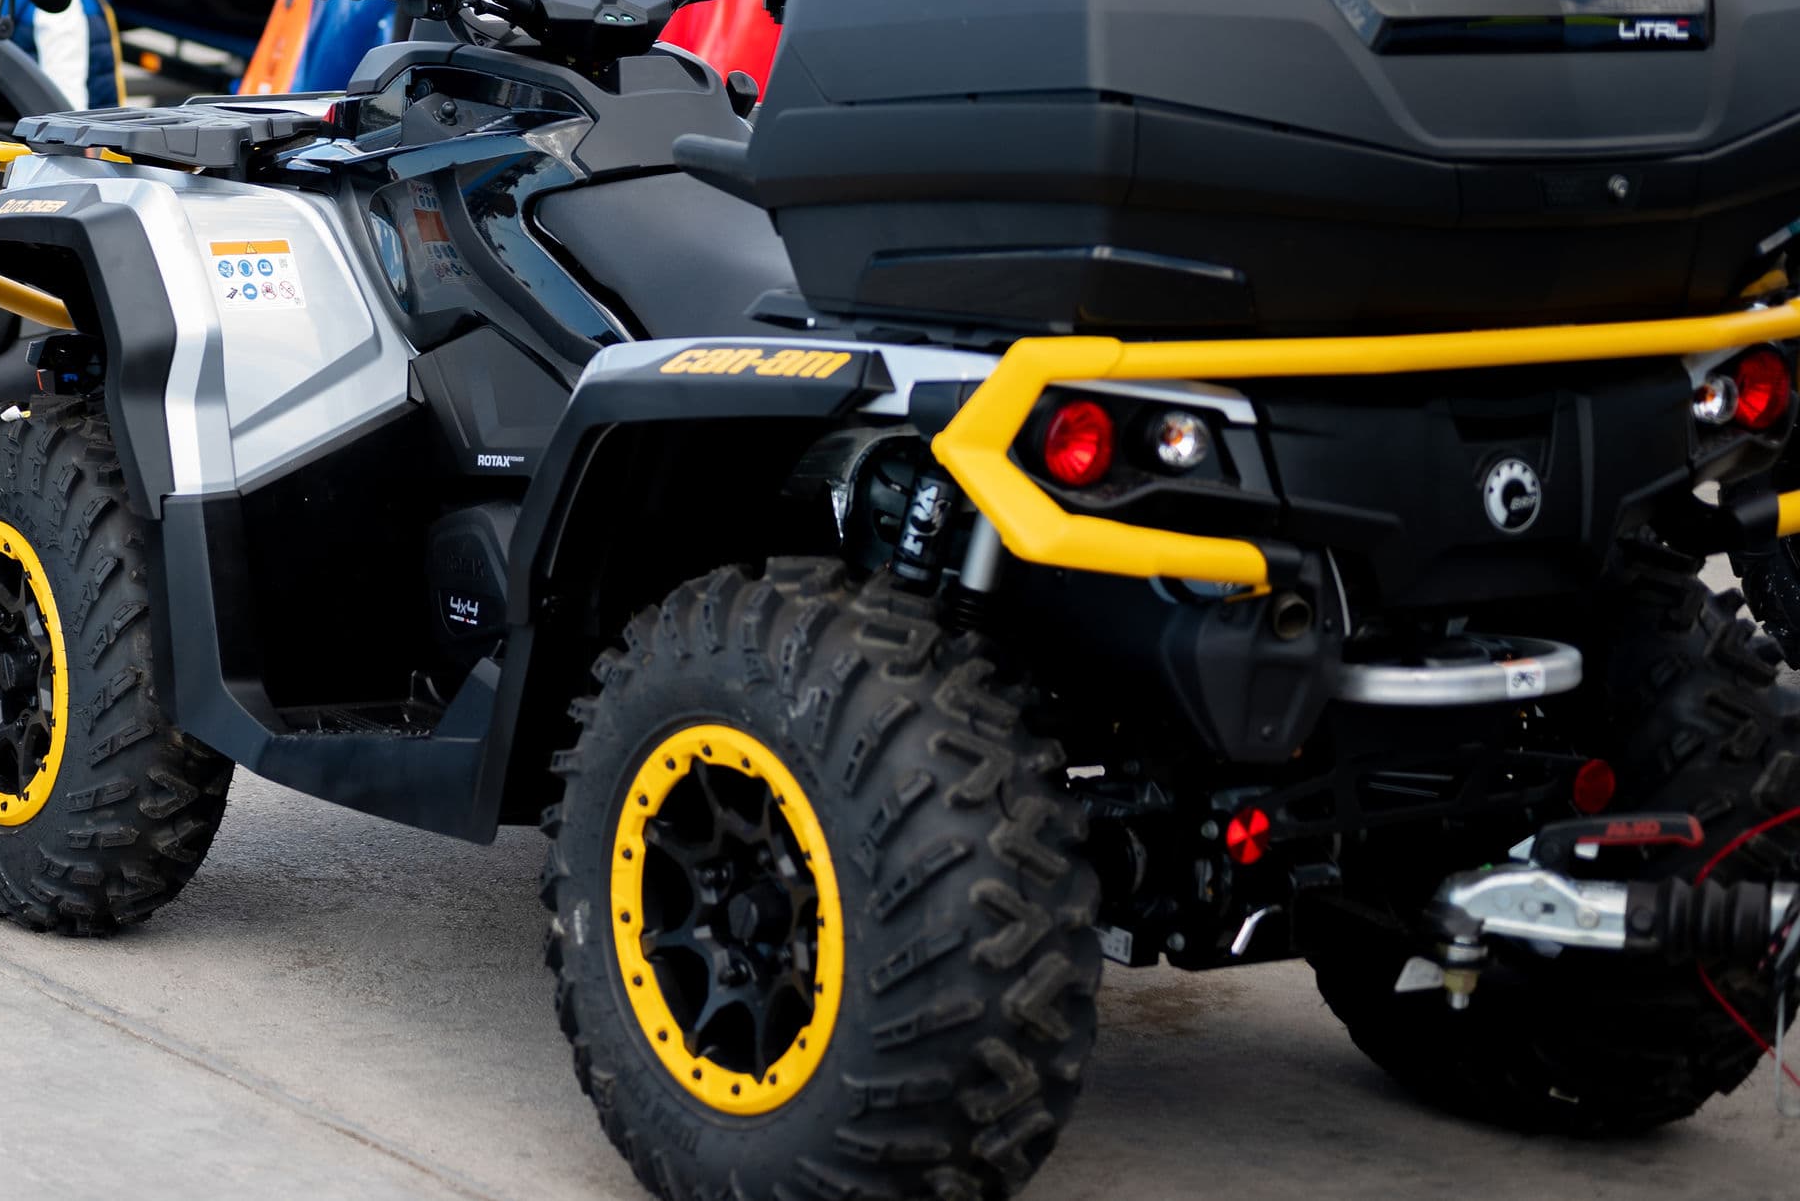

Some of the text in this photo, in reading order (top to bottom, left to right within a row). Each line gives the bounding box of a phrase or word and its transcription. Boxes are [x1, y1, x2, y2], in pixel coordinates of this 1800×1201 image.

[659, 349, 851, 379] can-am
[477, 454, 510, 467] ROTAX
[449, 596, 479, 617] 4x4
